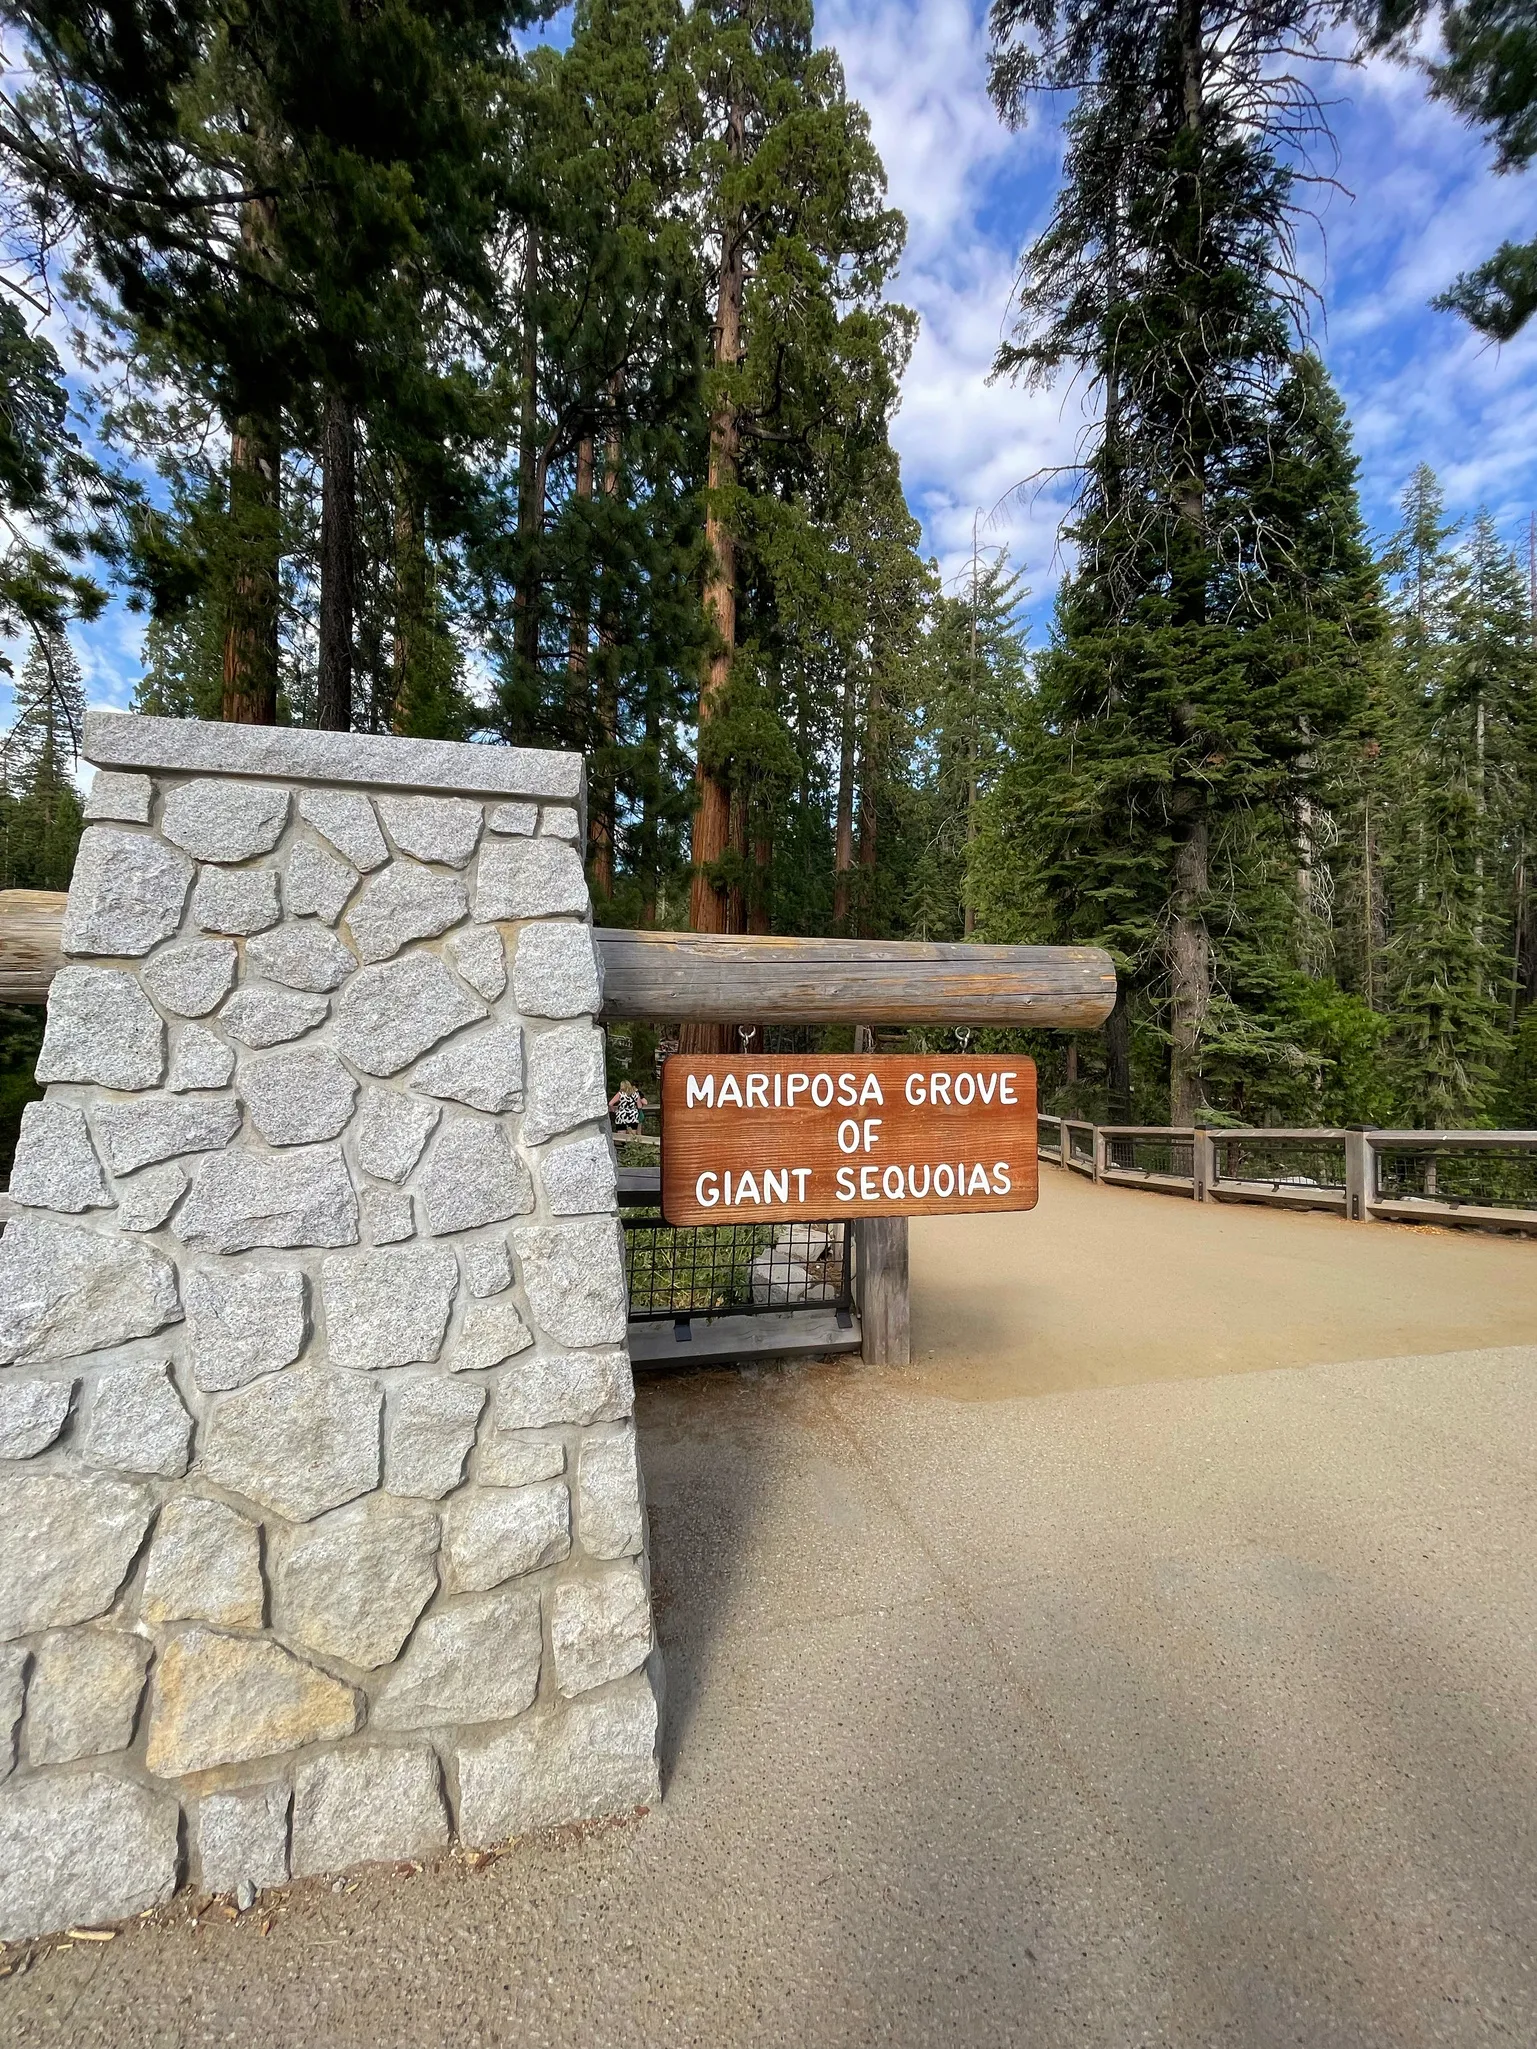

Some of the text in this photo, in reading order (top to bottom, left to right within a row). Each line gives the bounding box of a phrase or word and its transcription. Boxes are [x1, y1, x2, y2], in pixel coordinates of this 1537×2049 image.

[686, 1072, 1018, 1109] MARIPOSA GROVE
[837, 1118, 883, 1154] OF
[695, 1161, 1012, 1208] GIANT SEQUOIAS
